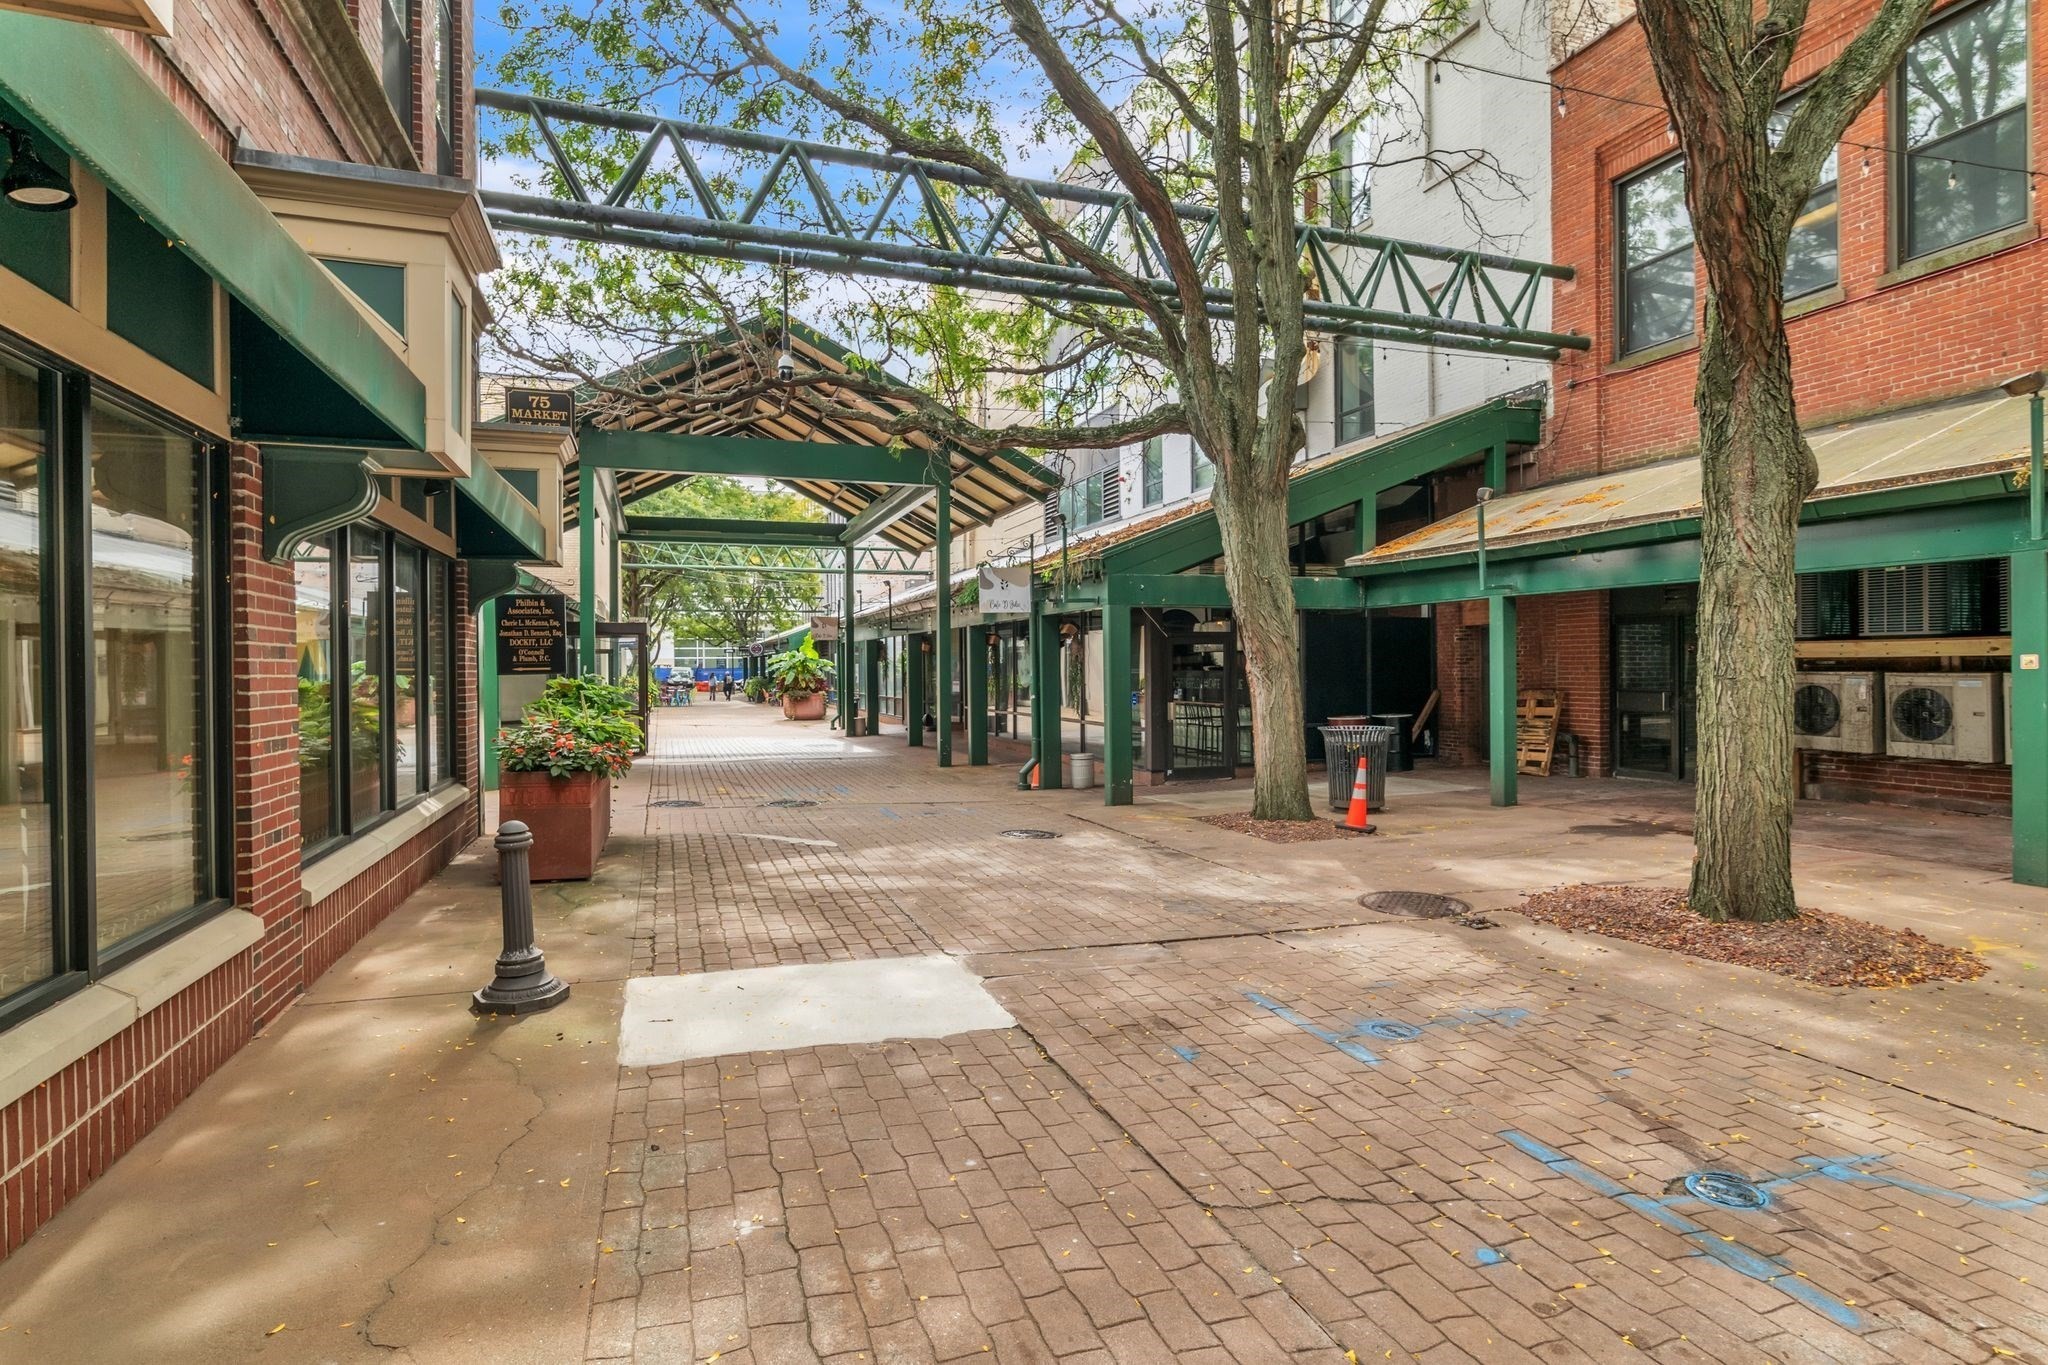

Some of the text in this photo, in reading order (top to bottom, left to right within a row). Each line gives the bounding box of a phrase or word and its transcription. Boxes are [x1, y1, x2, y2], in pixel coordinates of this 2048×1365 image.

[528, 395, 551, 409] 75
[511, 408, 568, 421] MARKET
[515, 599, 539, 607] Philbin
[507, 607, 555, 615] Associates, Inc.
[509, 638, 554, 647] DOCKIT, LLC
